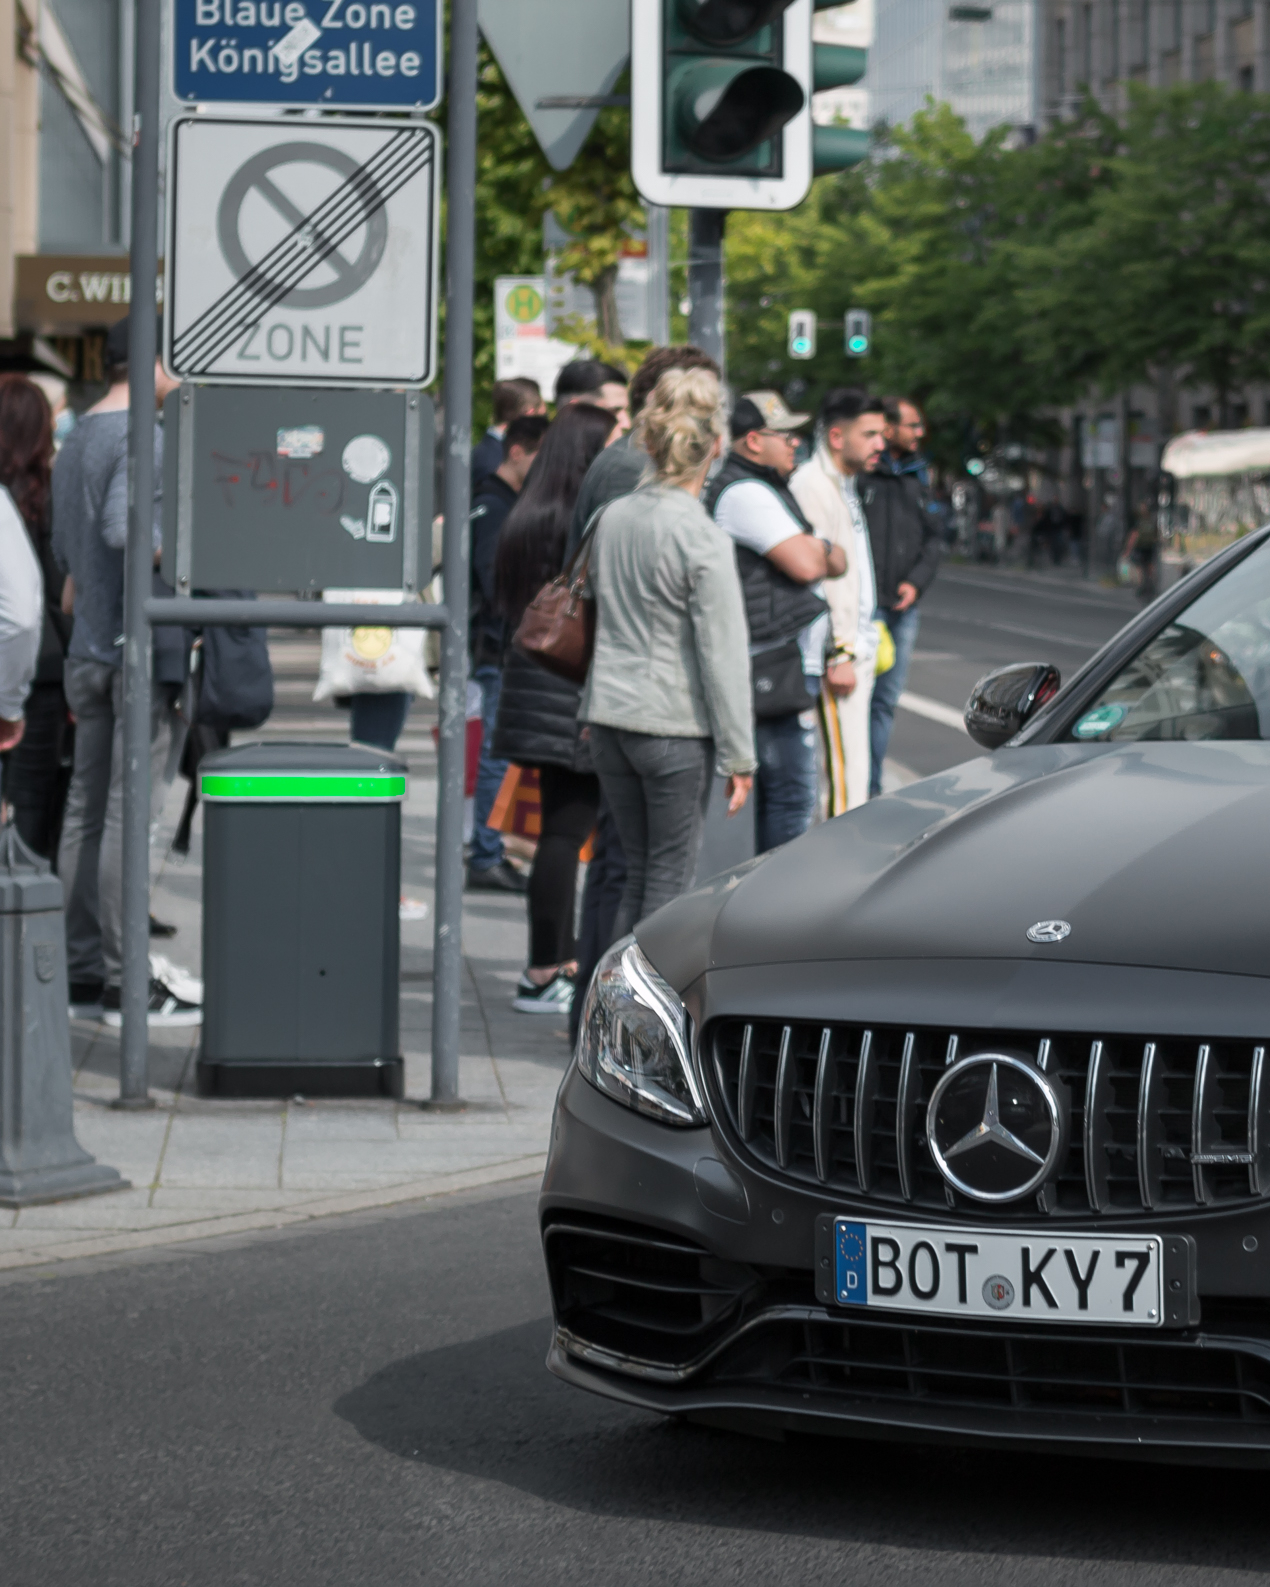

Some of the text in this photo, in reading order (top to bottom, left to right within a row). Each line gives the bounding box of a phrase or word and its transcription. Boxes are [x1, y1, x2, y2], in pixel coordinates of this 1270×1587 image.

[195, 0, 416, 30] Blaue Zone
[190, 37, 421, 83] Königsallee
[237, 322, 363, 363] ZONE
[846, 1270, 859, 1289] D
[870, 1236, 979, 1305] BOT
